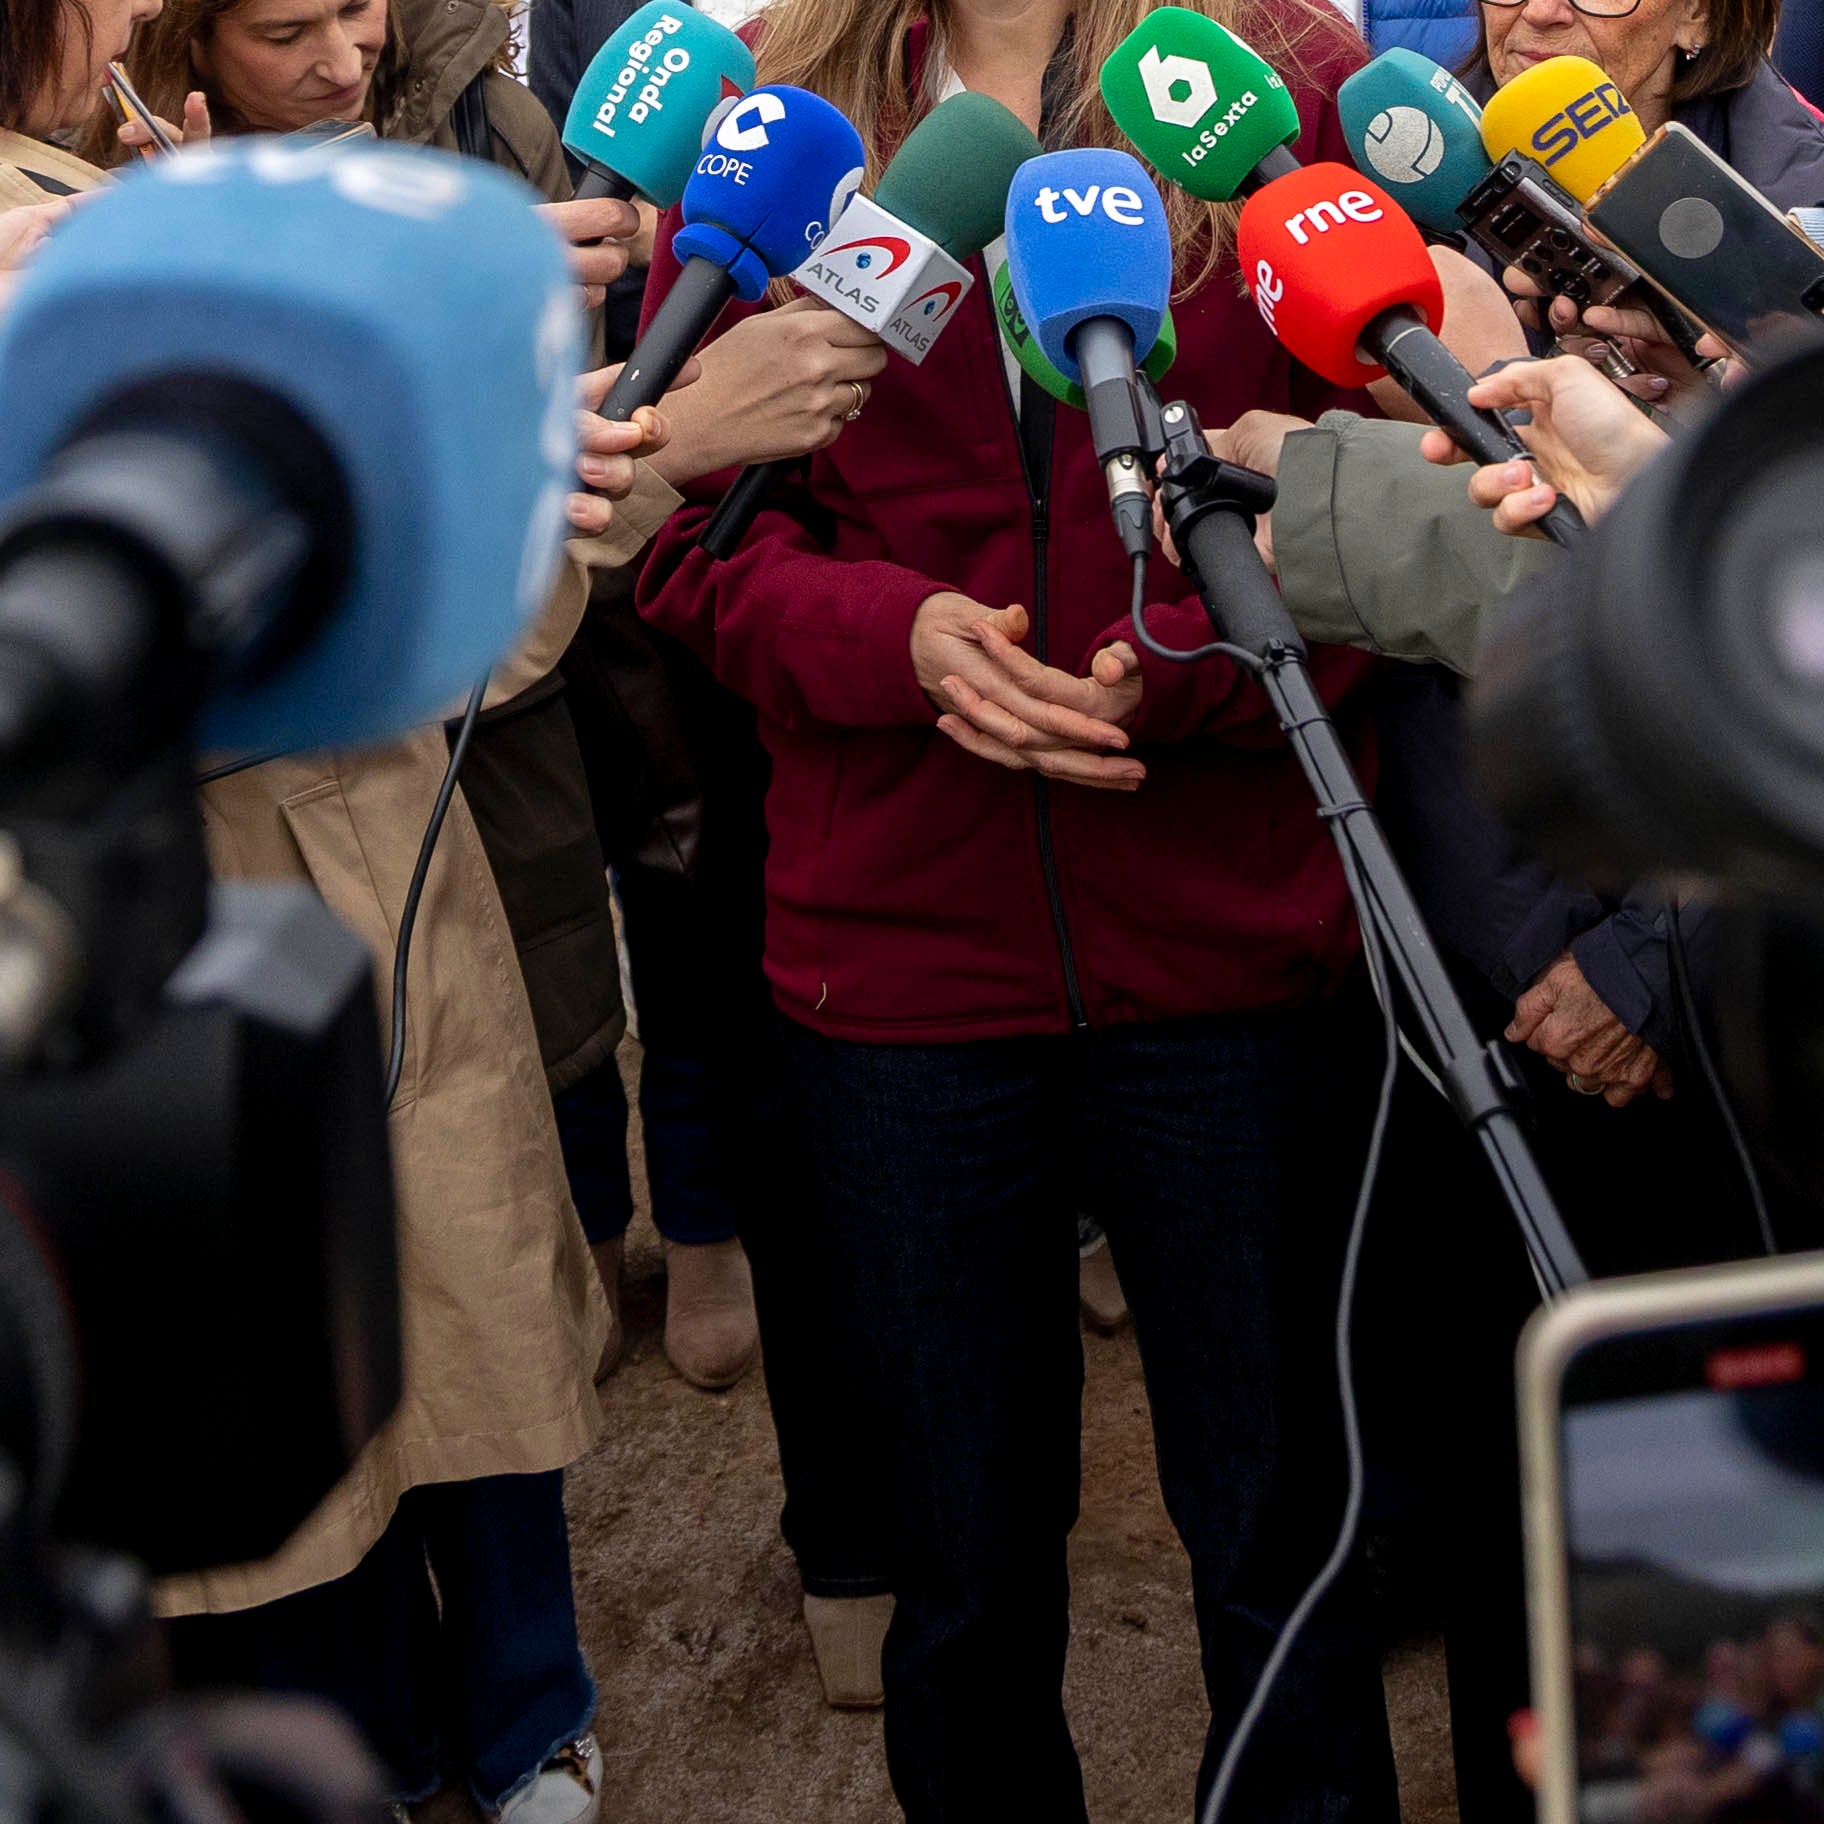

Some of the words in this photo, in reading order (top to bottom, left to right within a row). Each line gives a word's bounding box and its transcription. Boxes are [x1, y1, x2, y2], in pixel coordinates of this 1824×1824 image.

[592, 14, 684, 138] Regional
[628, 47, 690, 124] Onda
[696, 153, 753, 186] COPE
[1034, 185, 1145, 226] tve
[1284, 190, 1384, 245] rne
[805, 221, 825, 250] CO
[806, 262, 880, 314] ATLAS
[889, 317, 930, 353] ATLAS
